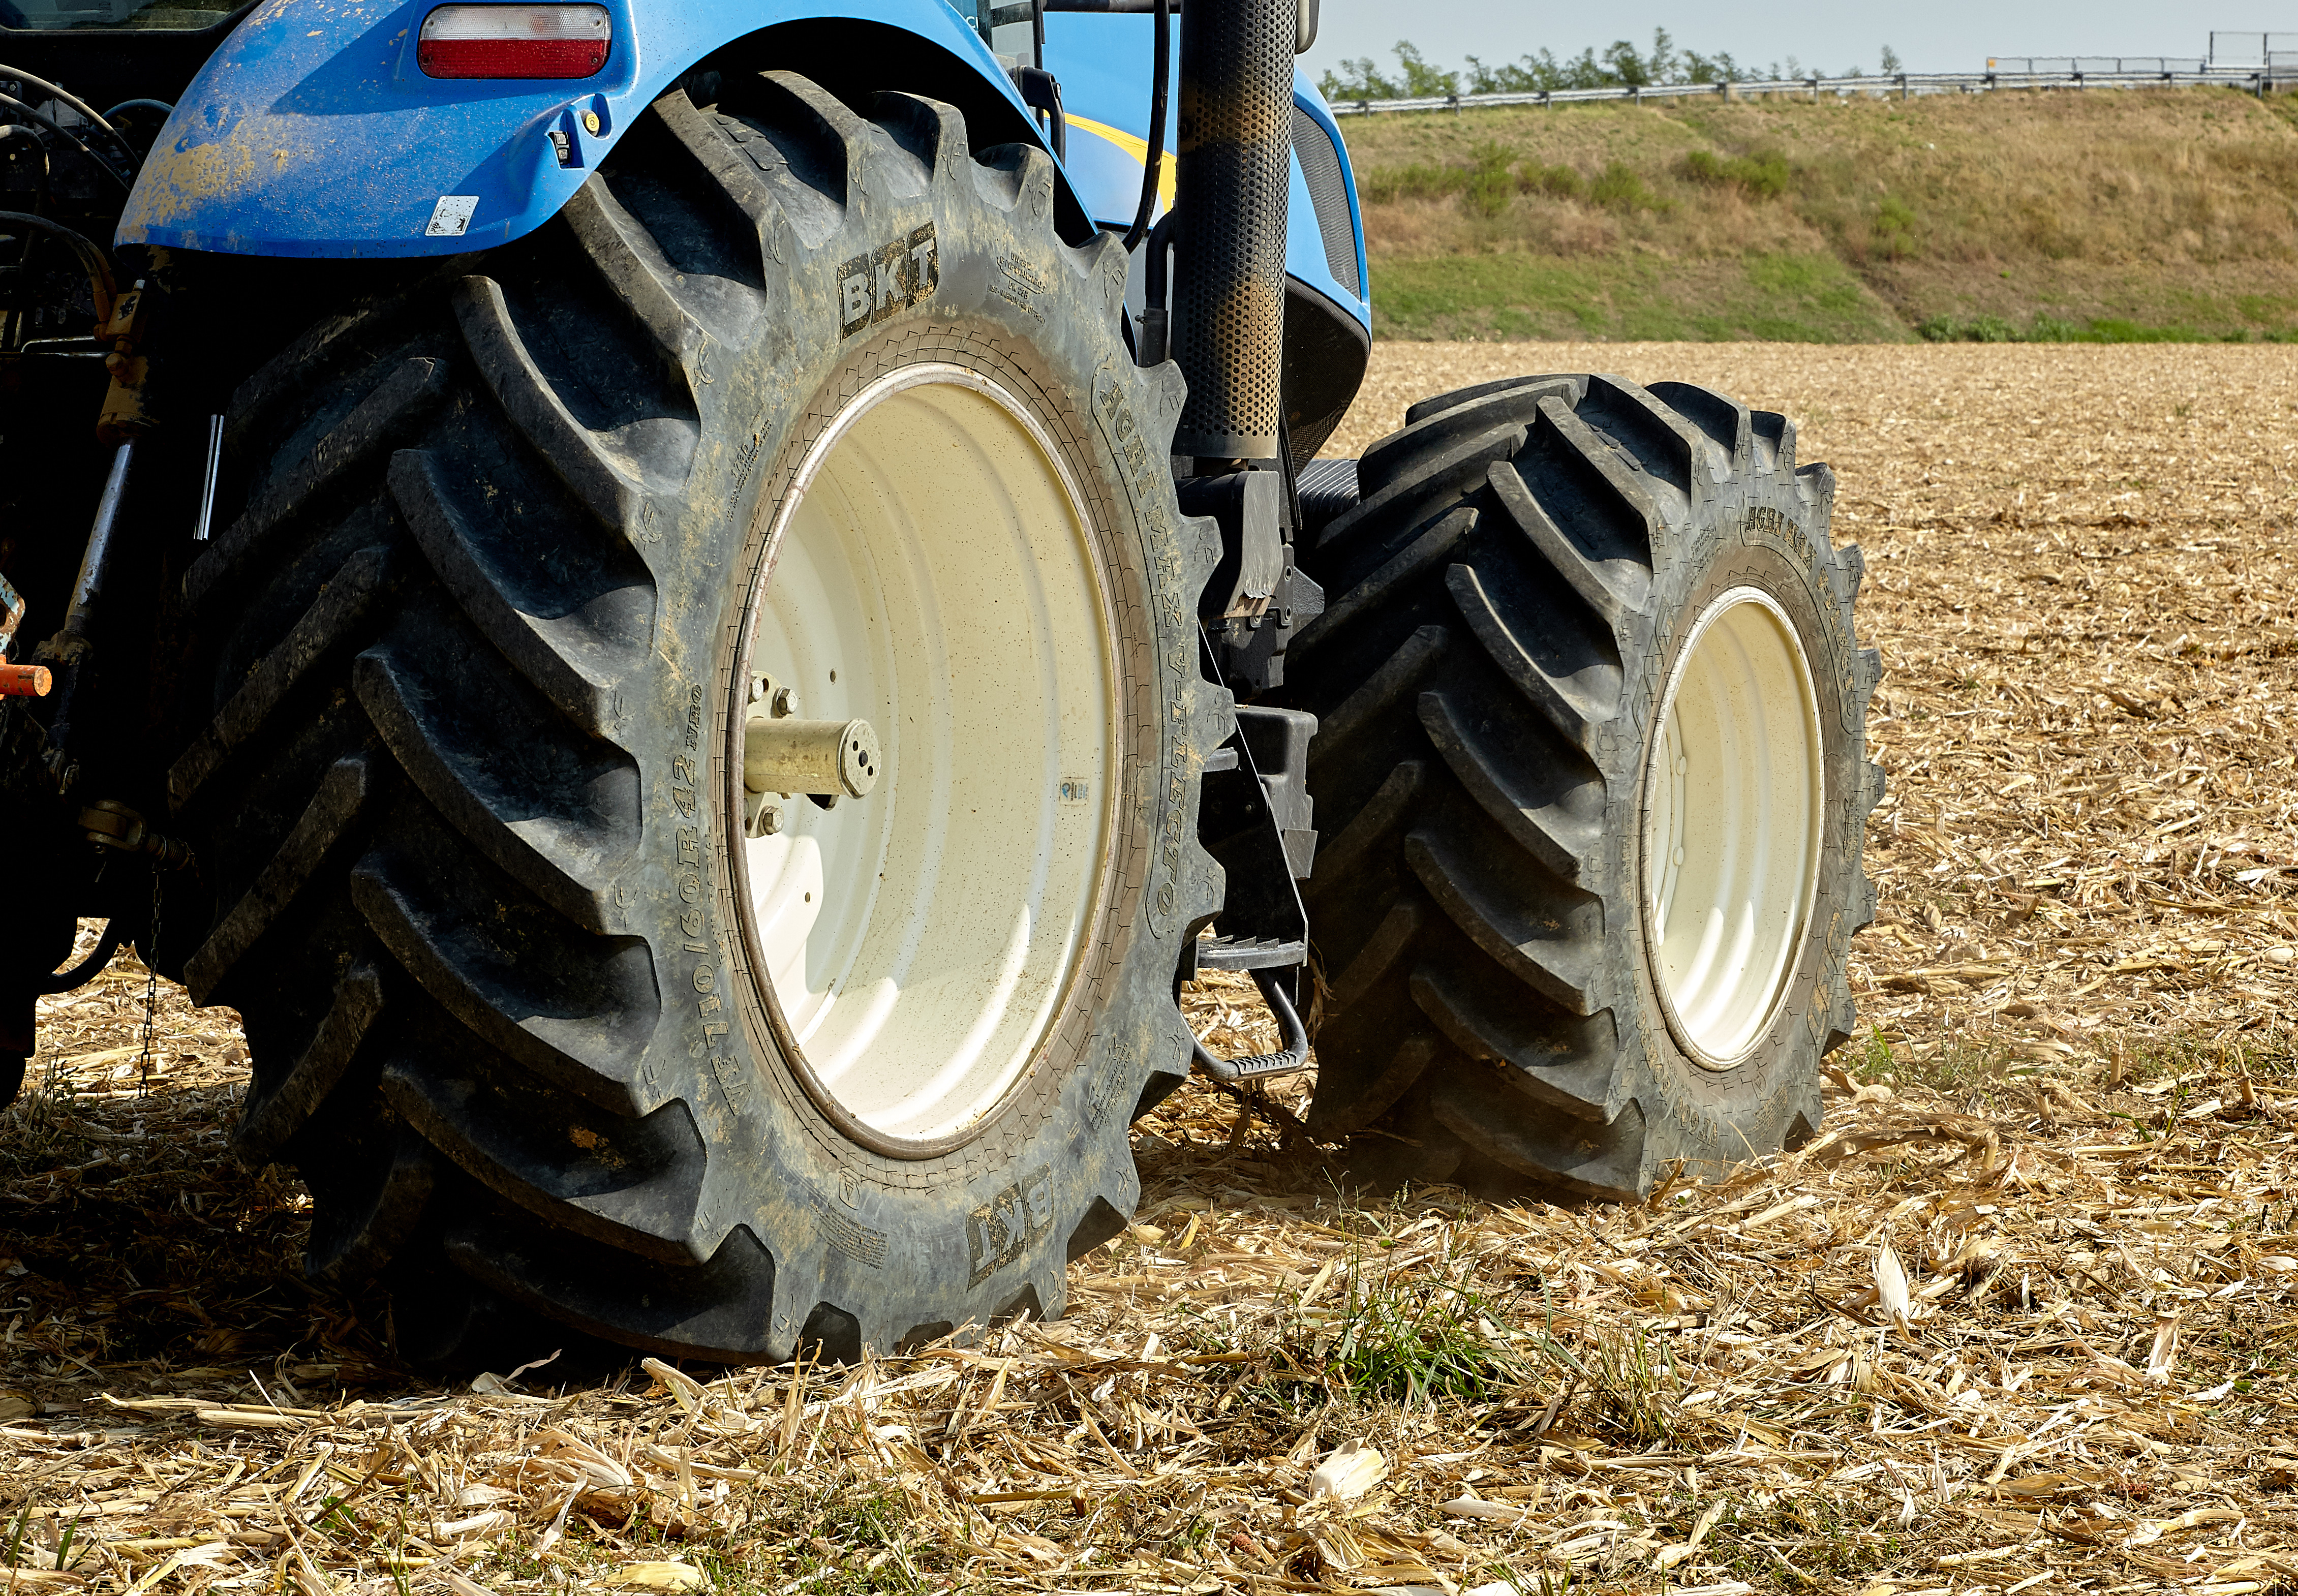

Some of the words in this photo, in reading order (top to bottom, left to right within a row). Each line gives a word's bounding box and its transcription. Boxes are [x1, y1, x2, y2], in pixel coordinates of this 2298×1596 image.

[840, 229, 936, 331] BKT
[1817, 566, 1856, 717] V-FLECTO
[685, 683, 702, 751] NRO
[1157, 644, 1187, 916] V-FLECTO
[710, 1055, 751, 1117] VF
[972, 1170, 1053, 1280] BKT
